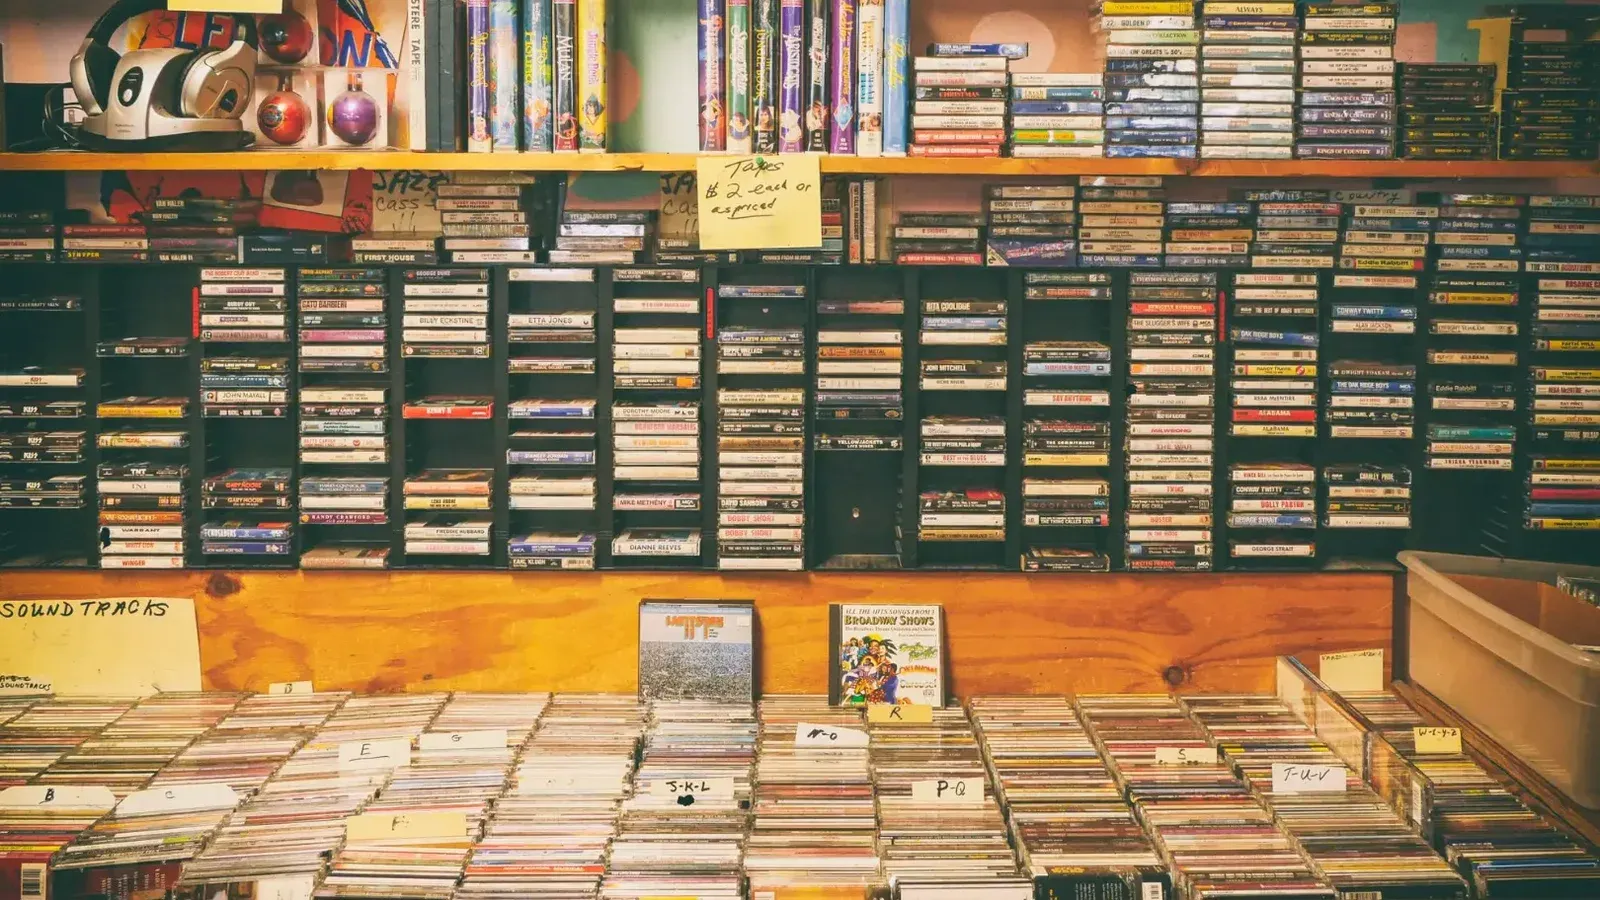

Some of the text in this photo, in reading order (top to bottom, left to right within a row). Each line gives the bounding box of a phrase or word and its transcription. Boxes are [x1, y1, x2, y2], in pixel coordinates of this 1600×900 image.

[411, 39, 420, 65] TAPE
[725, 158, 784, 179] Tapes
[727, 183, 742, 198] 2
[748, 179, 787, 195] each
[796, 182, 812, 192] or
[1335, 192, 1400, 204] Country
[728, 198, 776, 218] priced
[302, 300, 317, 308] GATO
[926, 302, 940, 311] RITA
[844, 615, 935, 626] BROADWAY SHOWS
[360, 744, 371, 756] E
[1177, 748, 1186, 760] S
[936, 780, 966, 798] P-Q
